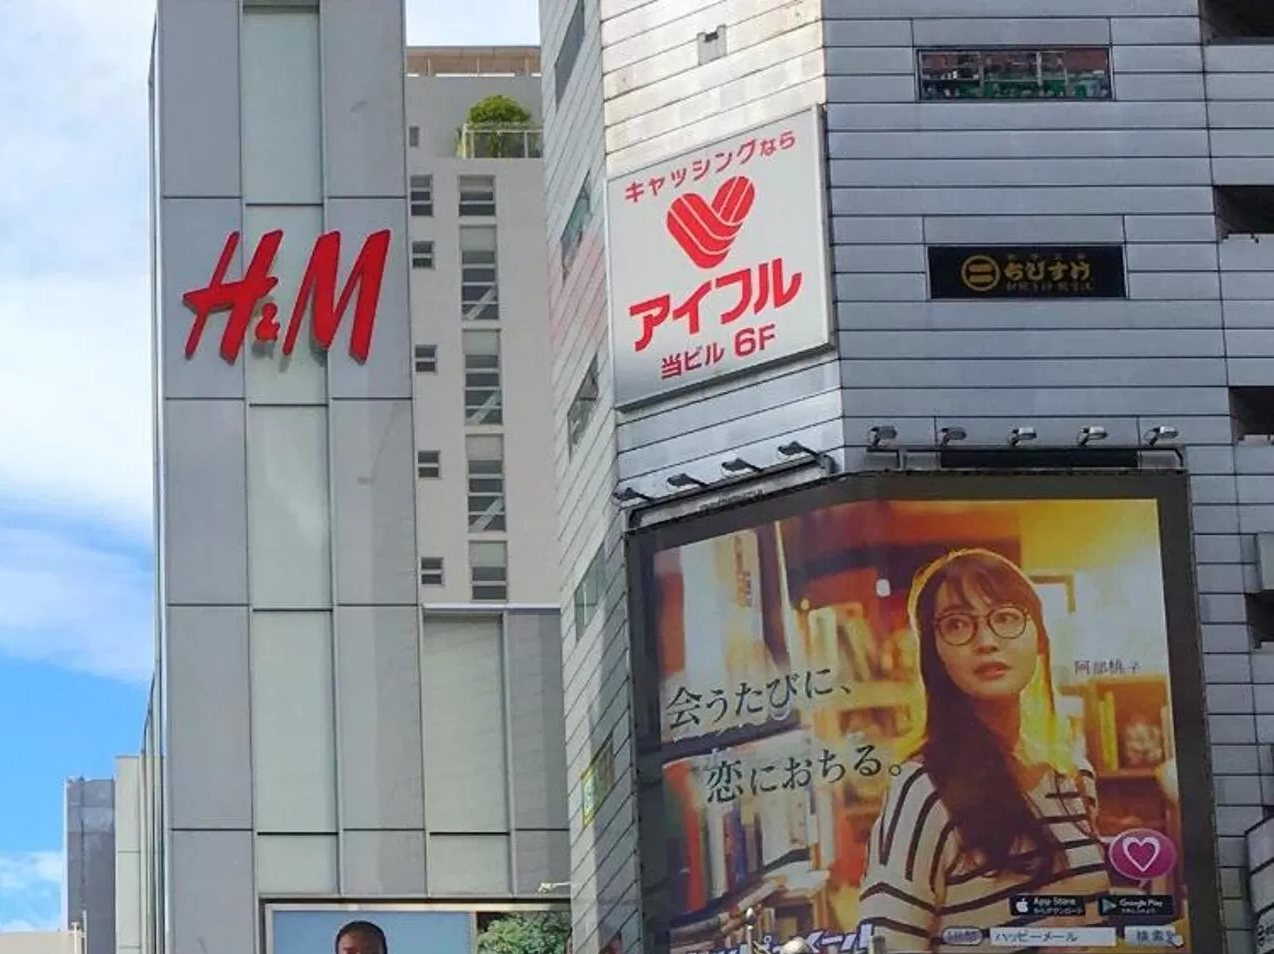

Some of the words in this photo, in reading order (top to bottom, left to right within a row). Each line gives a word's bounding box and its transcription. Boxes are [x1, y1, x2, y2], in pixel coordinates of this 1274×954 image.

[625, 130, 796, 203] キャッシングなら
[183, 229, 391, 366] H&M
[629, 258, 802, 351] アイフル
[661, 343, 725, 380] 当ビル
[734, 324, 776, 357] 6F
[666, 668, 851, 729] 会うたびに、
[707, 744, 903, 802] 恋におちる。
[995, 931, 1078, 943] ハッピーメール
